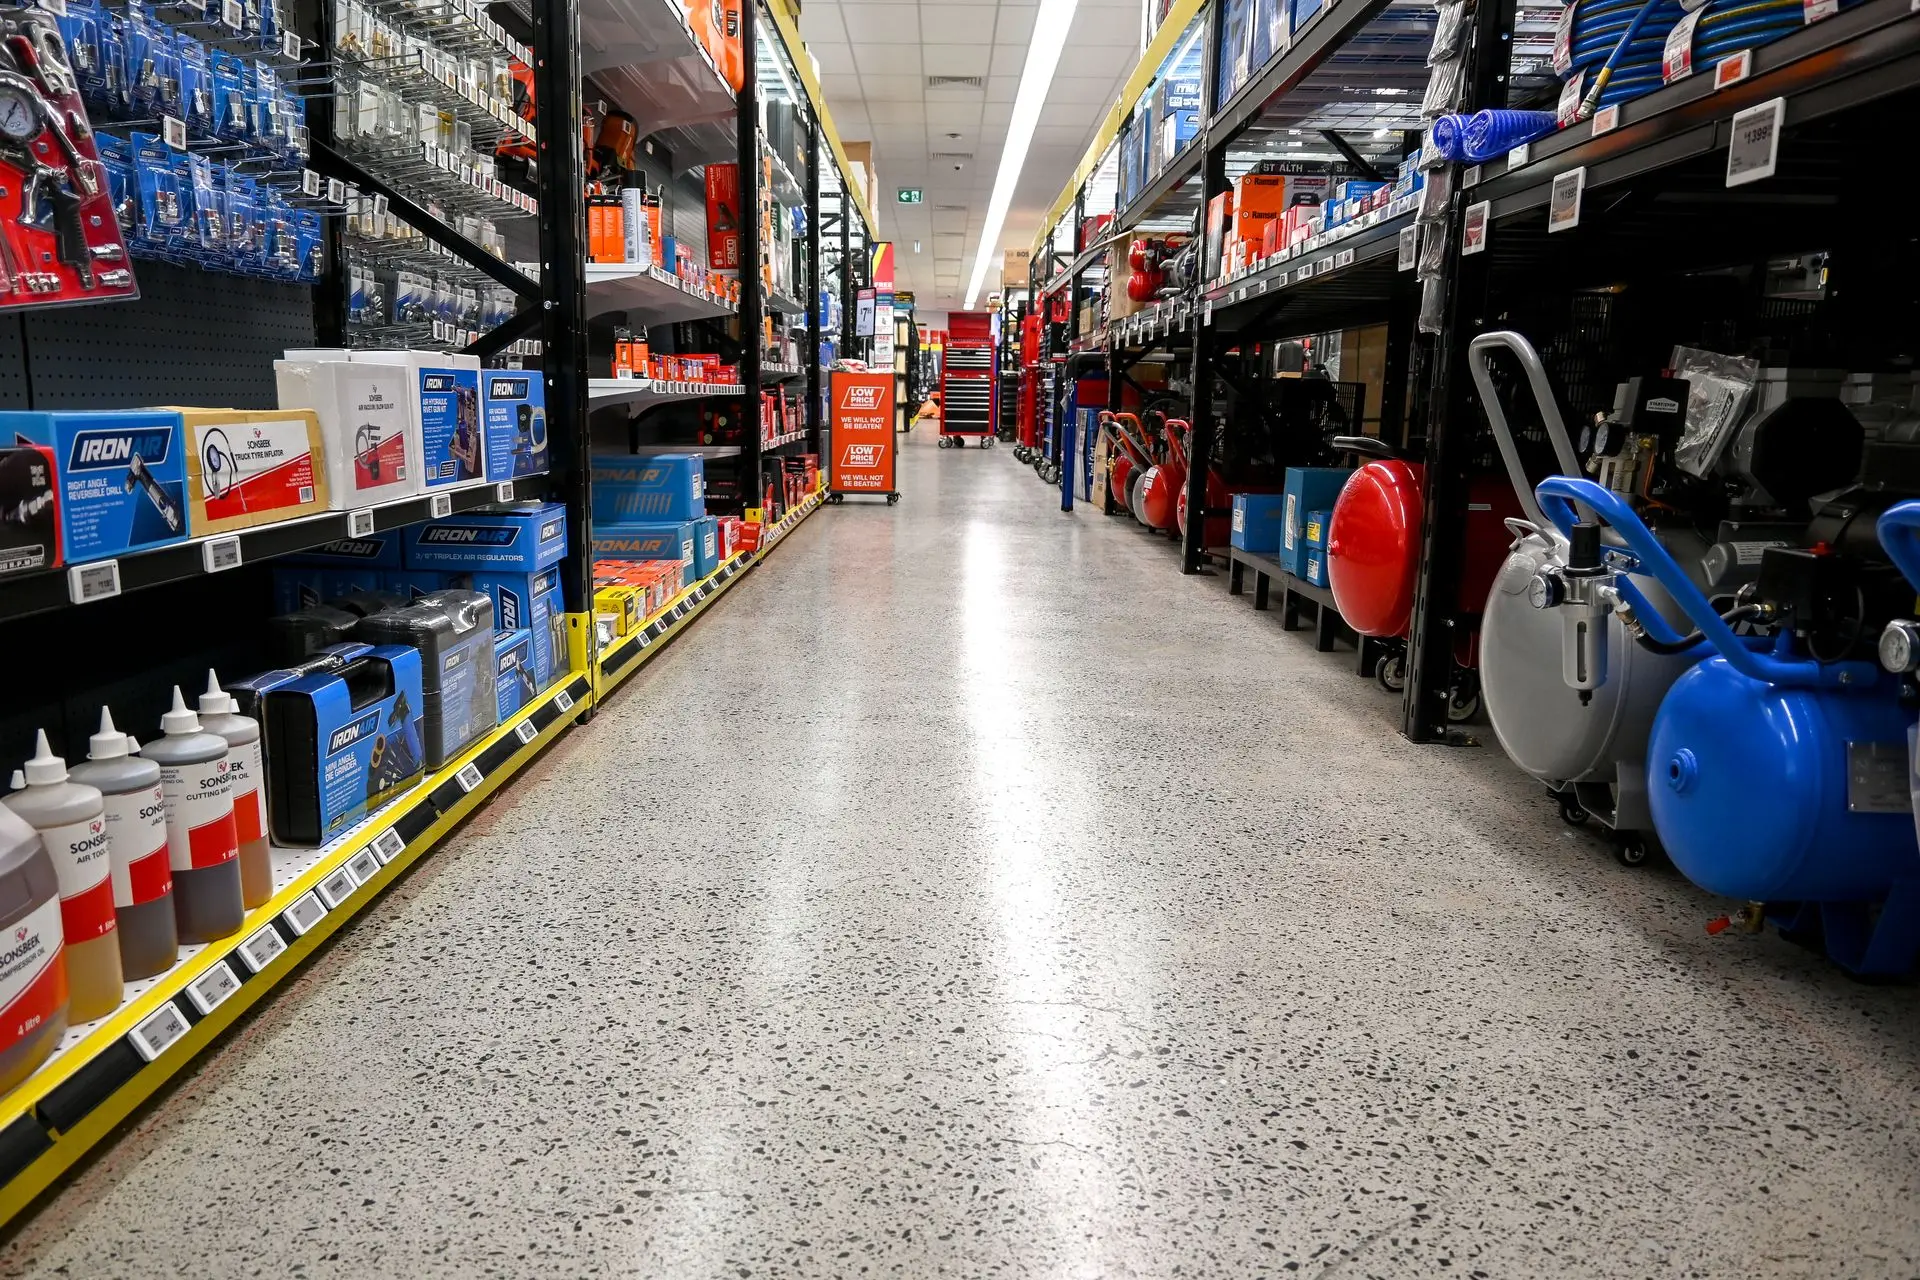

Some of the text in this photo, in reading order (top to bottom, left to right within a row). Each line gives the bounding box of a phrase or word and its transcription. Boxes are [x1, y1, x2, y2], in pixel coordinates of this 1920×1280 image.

[1263, 164, 1303, 172] STALTH
[851, 388, 874, 396] LOW
[80, 437, 162, 462] IRONAIR
[247, 440, 271, 449] SONSBEEK
[264, 450, 284, 458] INFLATOR
[67, 478, 108, 491] RIGHT ANGLE
[68, 486, 123, 501] REVERSIBLE DRILL
[428, 528, 510, 541] IRONAIR
[477, 554, 524, 562] REGULATORS
[332, 716, 377, 750] IRONAIR
[338, 751, 355, 766] ANGLE
[325, 759, 357, 782] DIE GRINDER
[186, 789, 220, 801] CUTTING
[140, 801, 165, 819] SONS
[77, 854, 91, 864] AIR
[98, 924, 104, 934] 1
[0, 953, 36, 982] OMPRESSOR
[18, 1014, 40, 1035] 4 litre
